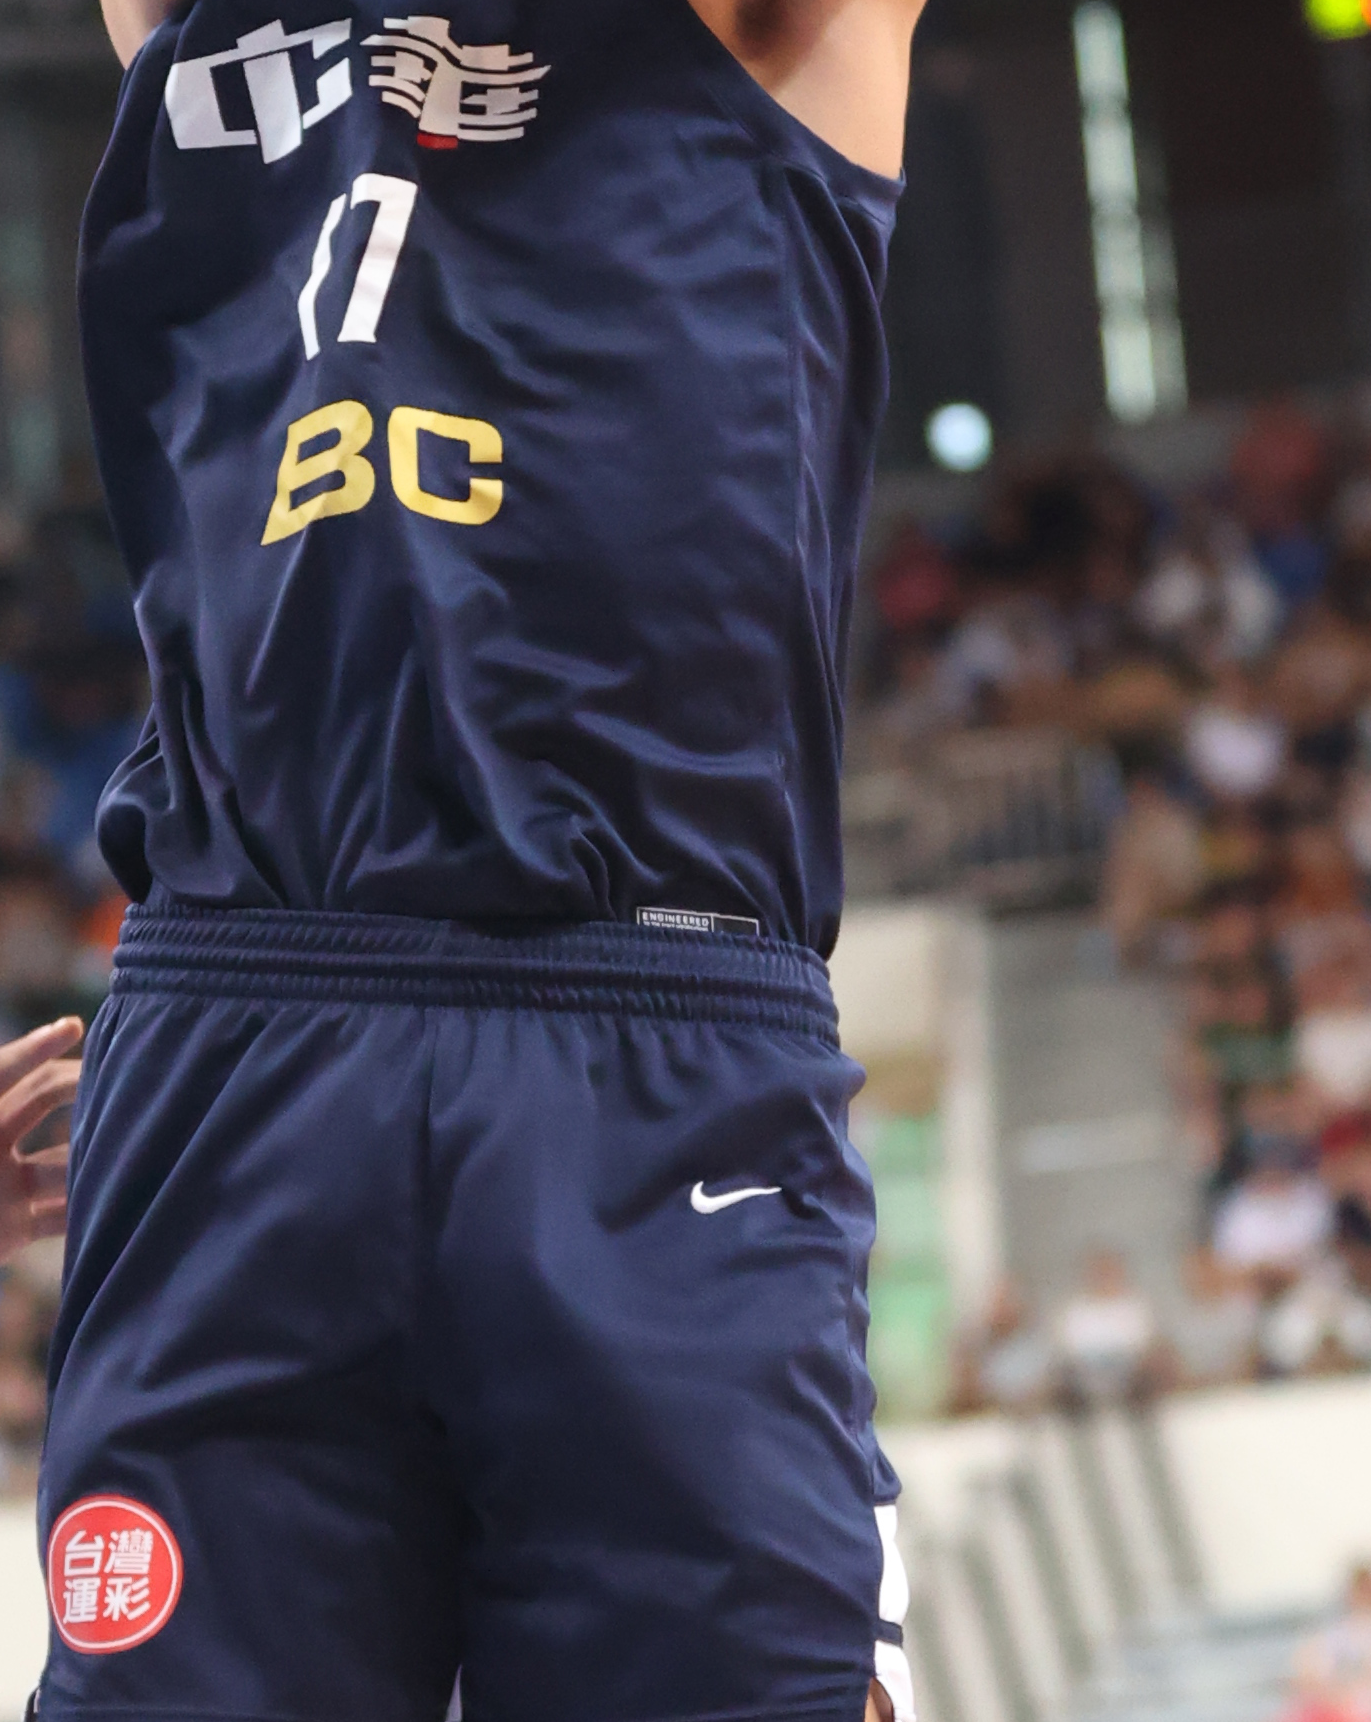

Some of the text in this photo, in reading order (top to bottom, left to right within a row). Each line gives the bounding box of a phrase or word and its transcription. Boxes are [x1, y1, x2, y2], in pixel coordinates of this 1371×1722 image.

[166, 16, 551, 163] 中華
[261, 399, 504, 545] BC
[63, 1577, 151, 1624] 運彩
[64, 1528, 154, 1577] 台灣
